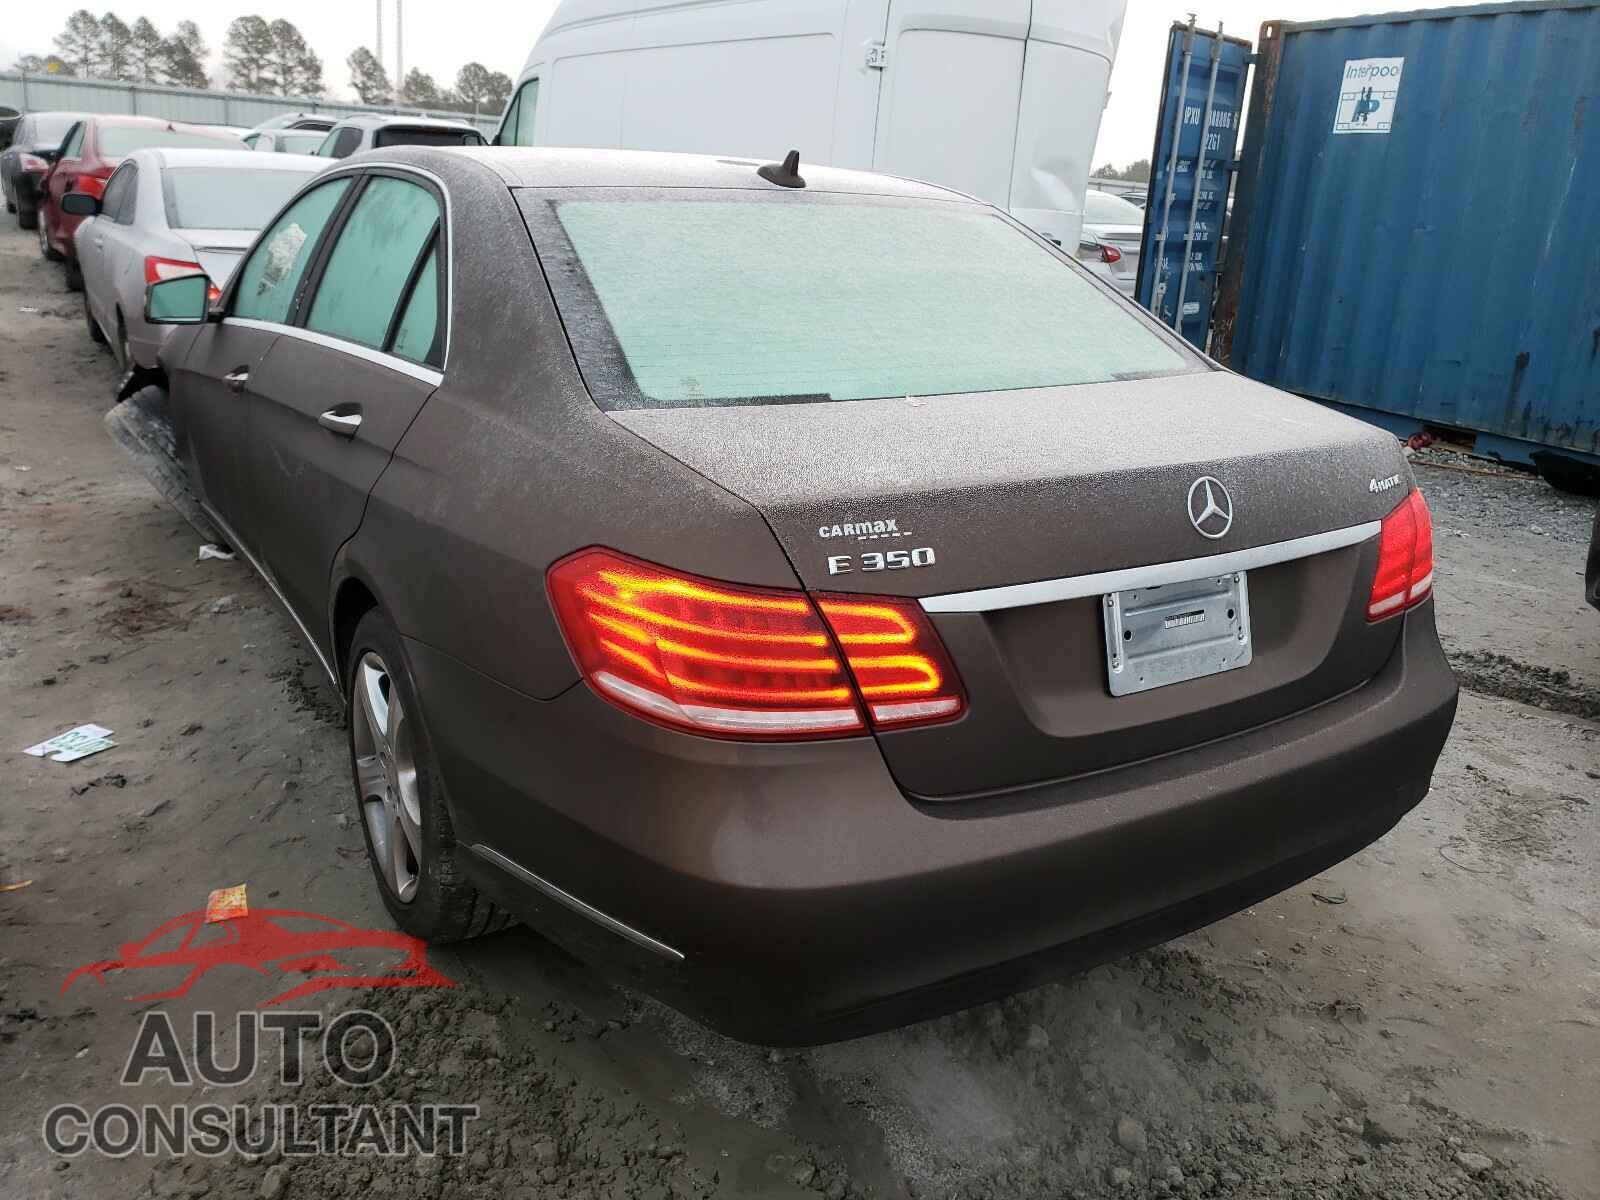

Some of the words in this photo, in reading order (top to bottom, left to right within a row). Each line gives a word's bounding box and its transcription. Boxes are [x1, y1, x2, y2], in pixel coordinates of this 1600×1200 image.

[1344, 64, 1399, 80] Interpoo
[827, 556, 854, 575] E
[861, 547, 936, 572] 350
